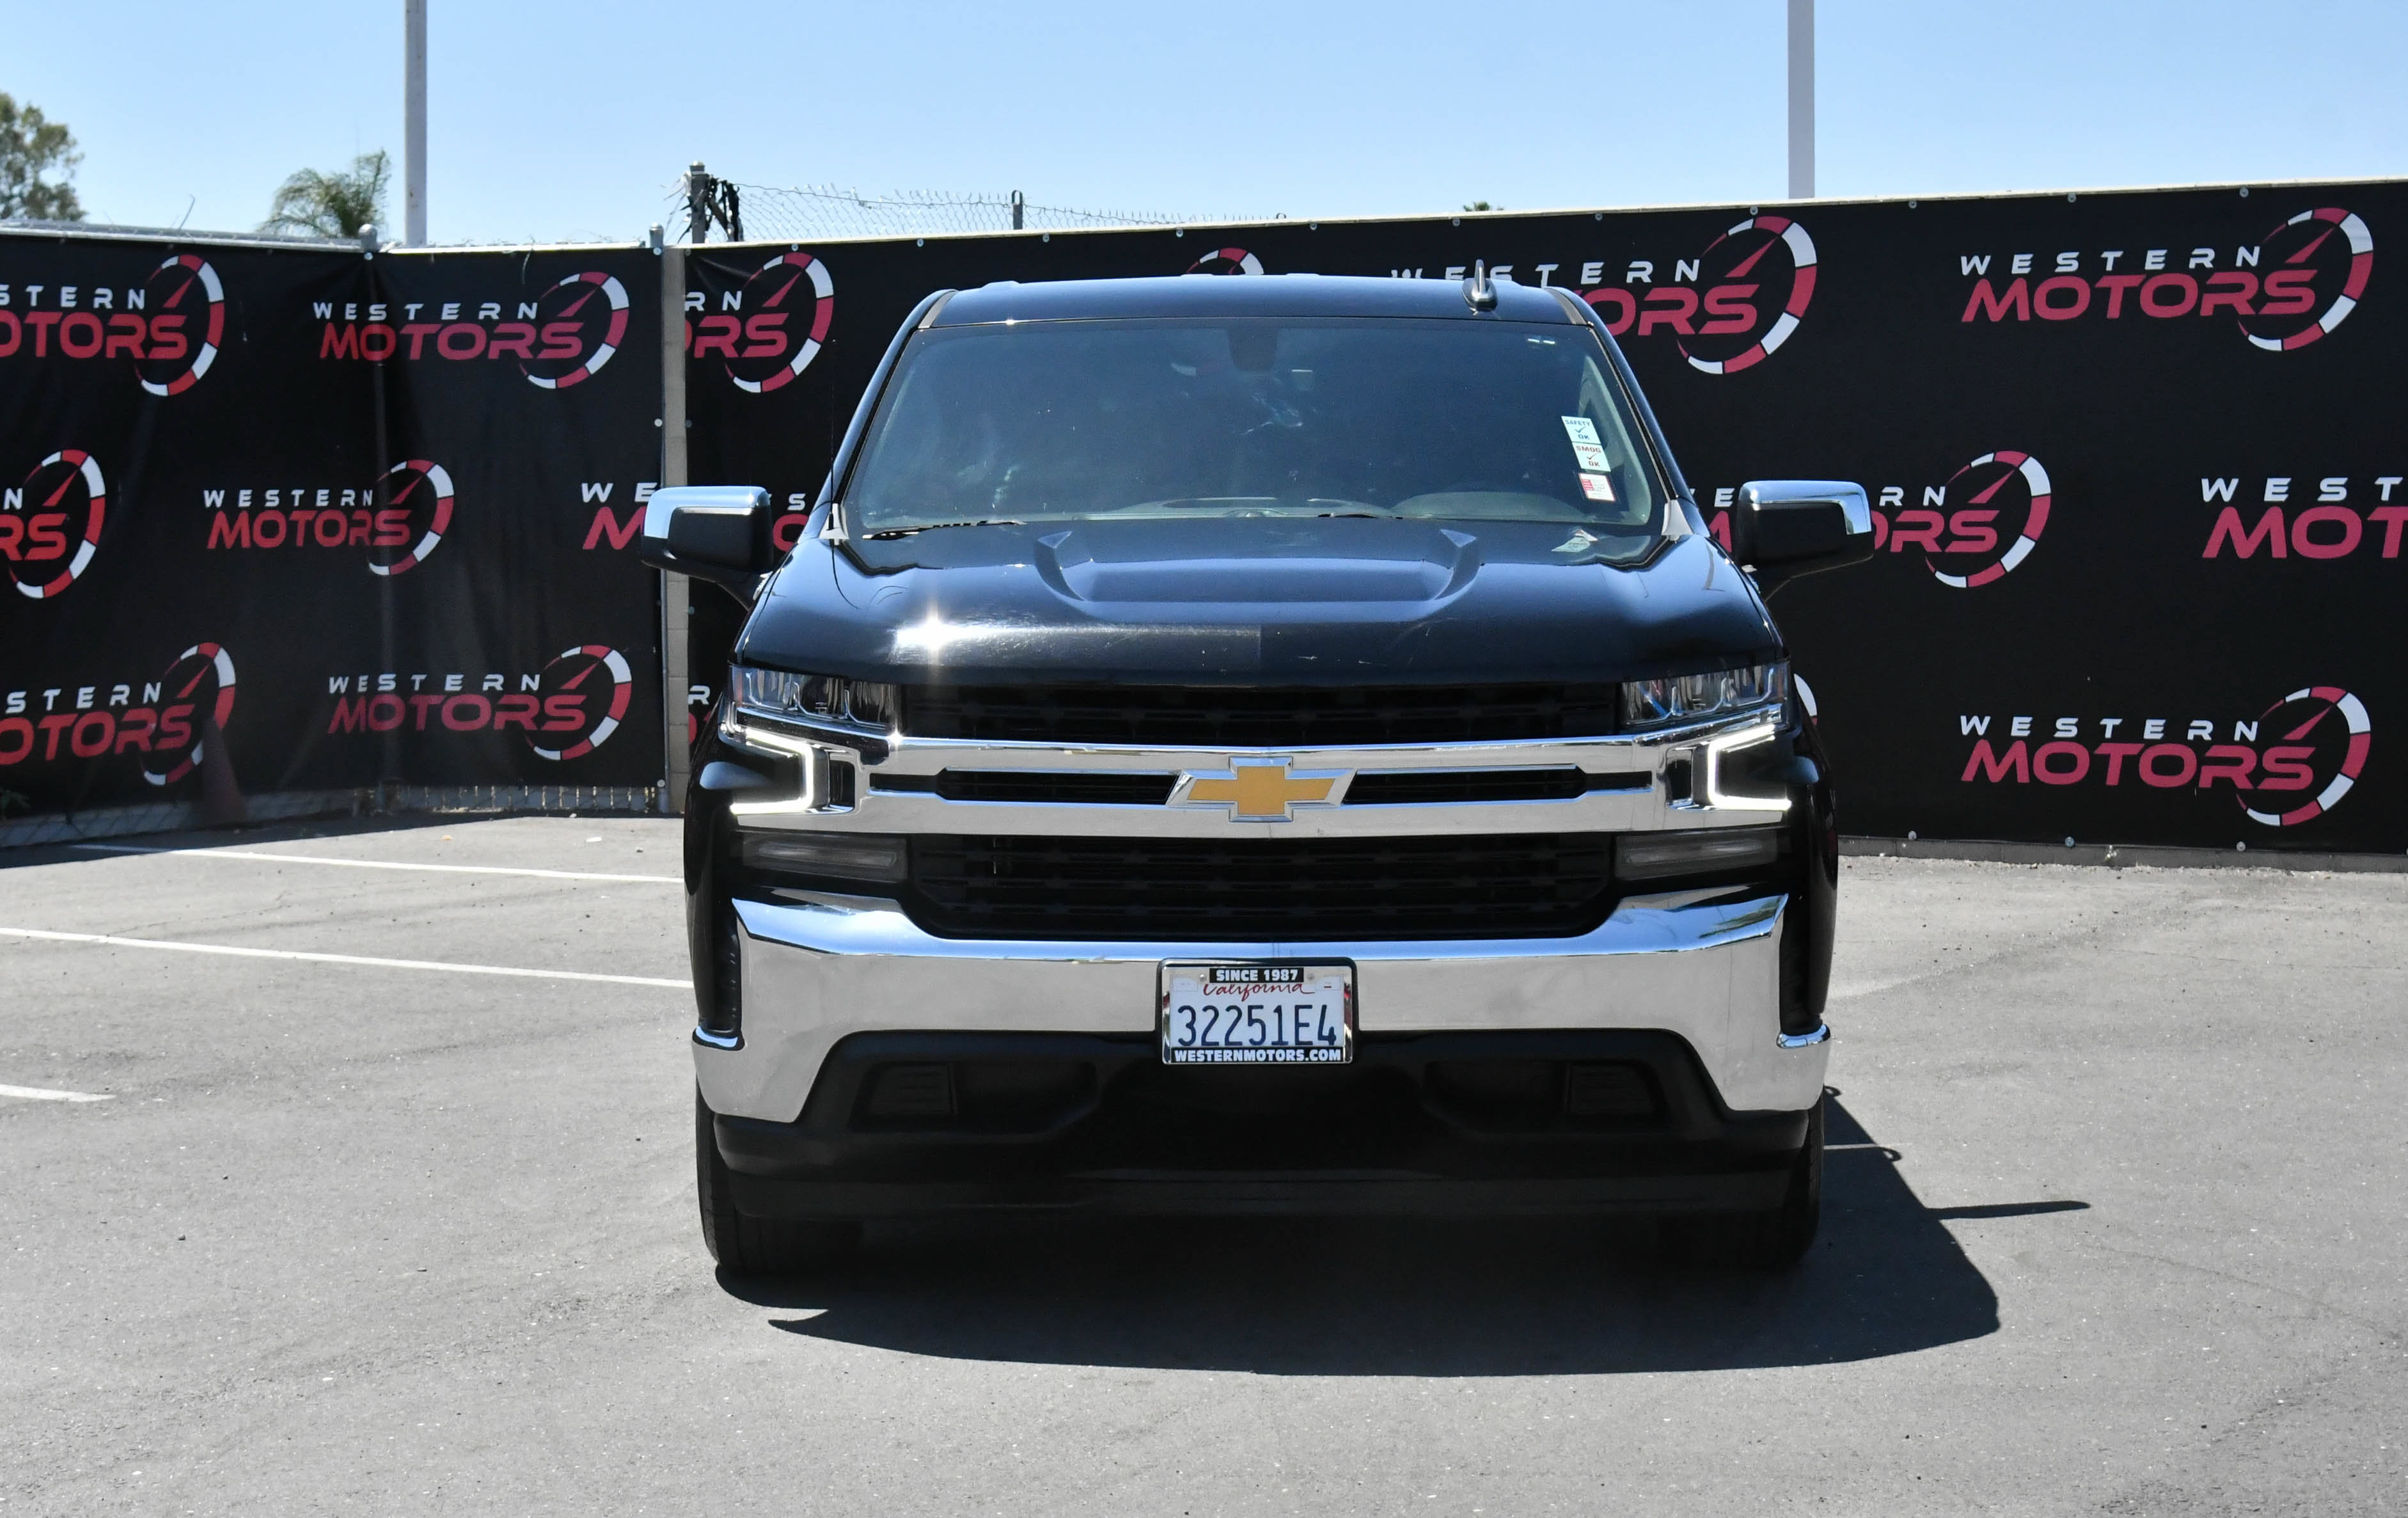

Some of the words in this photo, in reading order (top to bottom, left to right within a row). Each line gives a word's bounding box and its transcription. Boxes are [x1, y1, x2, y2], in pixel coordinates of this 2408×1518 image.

[1960, 246, 2260, 276] WESTERN
[0, 284, 145, 310] STERN
[313, 302, 538, 321] WESTERN
[1961, 269, 2318, 322] MOTORS
[0, 309, 188, 360] OTORS
[320, 322, 583, 361] MOTORS
[203, 489, 374, 508] WESTERN
[2201, 477, 2404, 502] WEST
[207, 509, 411, 549] MOTORS
[2201, 505, 2408, 559] MOT
[5, 682, 161, 714] STERN
[329, 674, 540, 694] WESTERN
[329, 694, 587, 733] MOTORS
[1960, 715, 2259, 742] WESTERN
[0, 704, 195, 765] OTORS
[1961, 738, 2316, 791] MOTORS
[1216, 969, 1258, 981] SINCE
[1263, 969, 1298, 981] 1987
[1177, 1004, 1338, 1047] 32251E4
[1174, 1049, 1341, 1062] WESTERNMOTORS.COM
